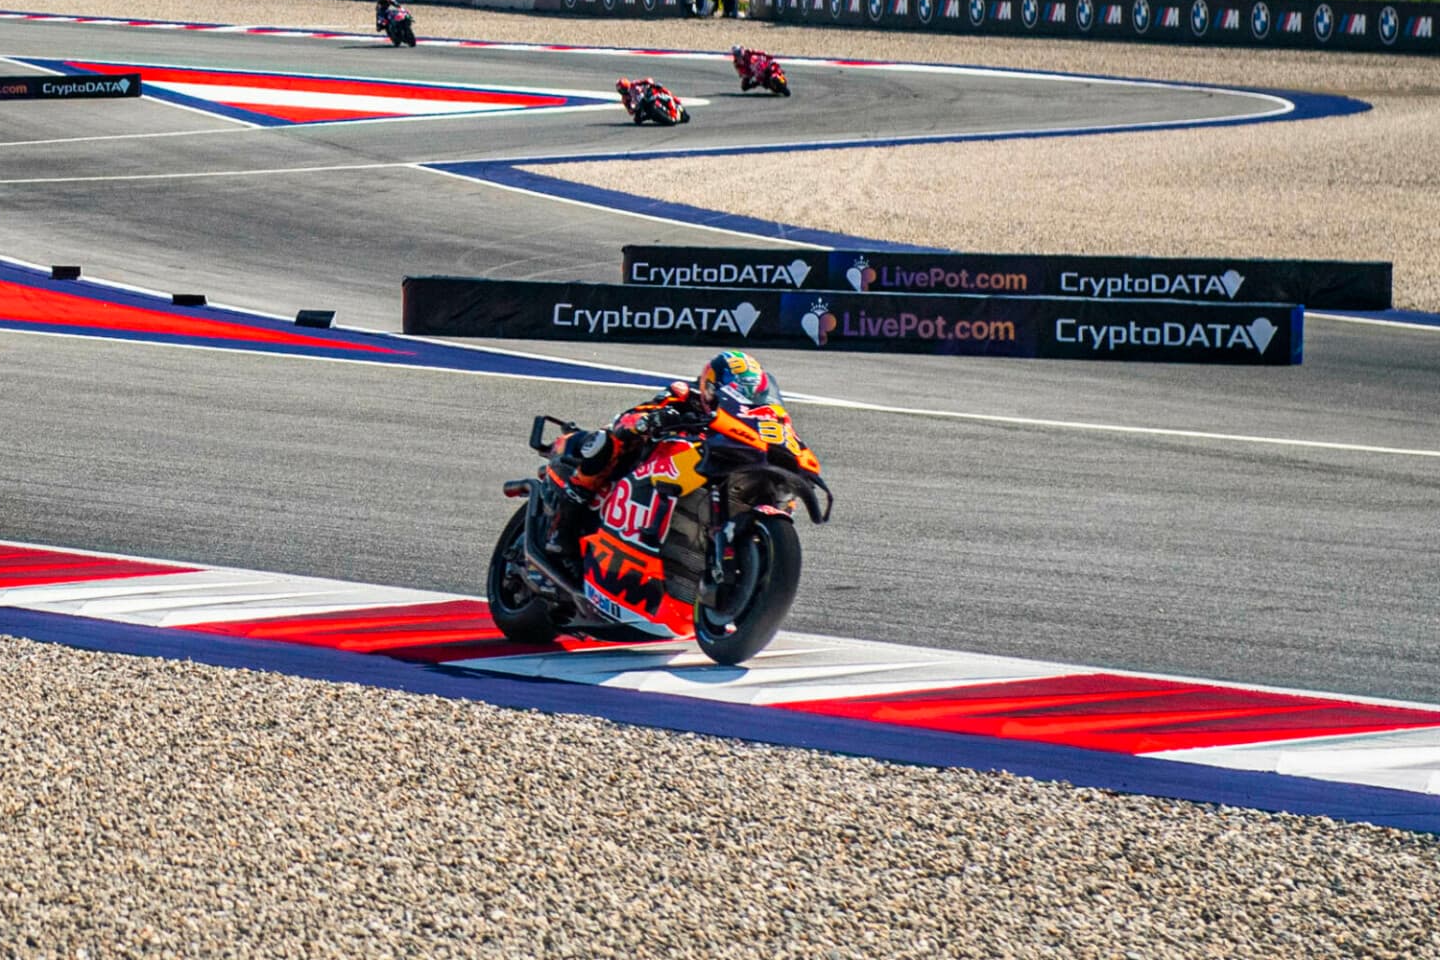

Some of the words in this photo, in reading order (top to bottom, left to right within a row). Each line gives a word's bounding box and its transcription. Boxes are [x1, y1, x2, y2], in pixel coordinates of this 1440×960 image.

[42, 81, 120, 97] CryptoDATA
[632, 262, 789, 286] CryptoDATA
[881, 266, 1027, 290] LivePot.com
[1061, 271, 1222, 298] CryptoDATA
[553, 302, 734, 333] CryptoDATA
[843, 310, 1016, 341] LivePot.com
[1056, 317, 1251, 350] CryptoDATA
[583, 536, 664, 617] KTM
